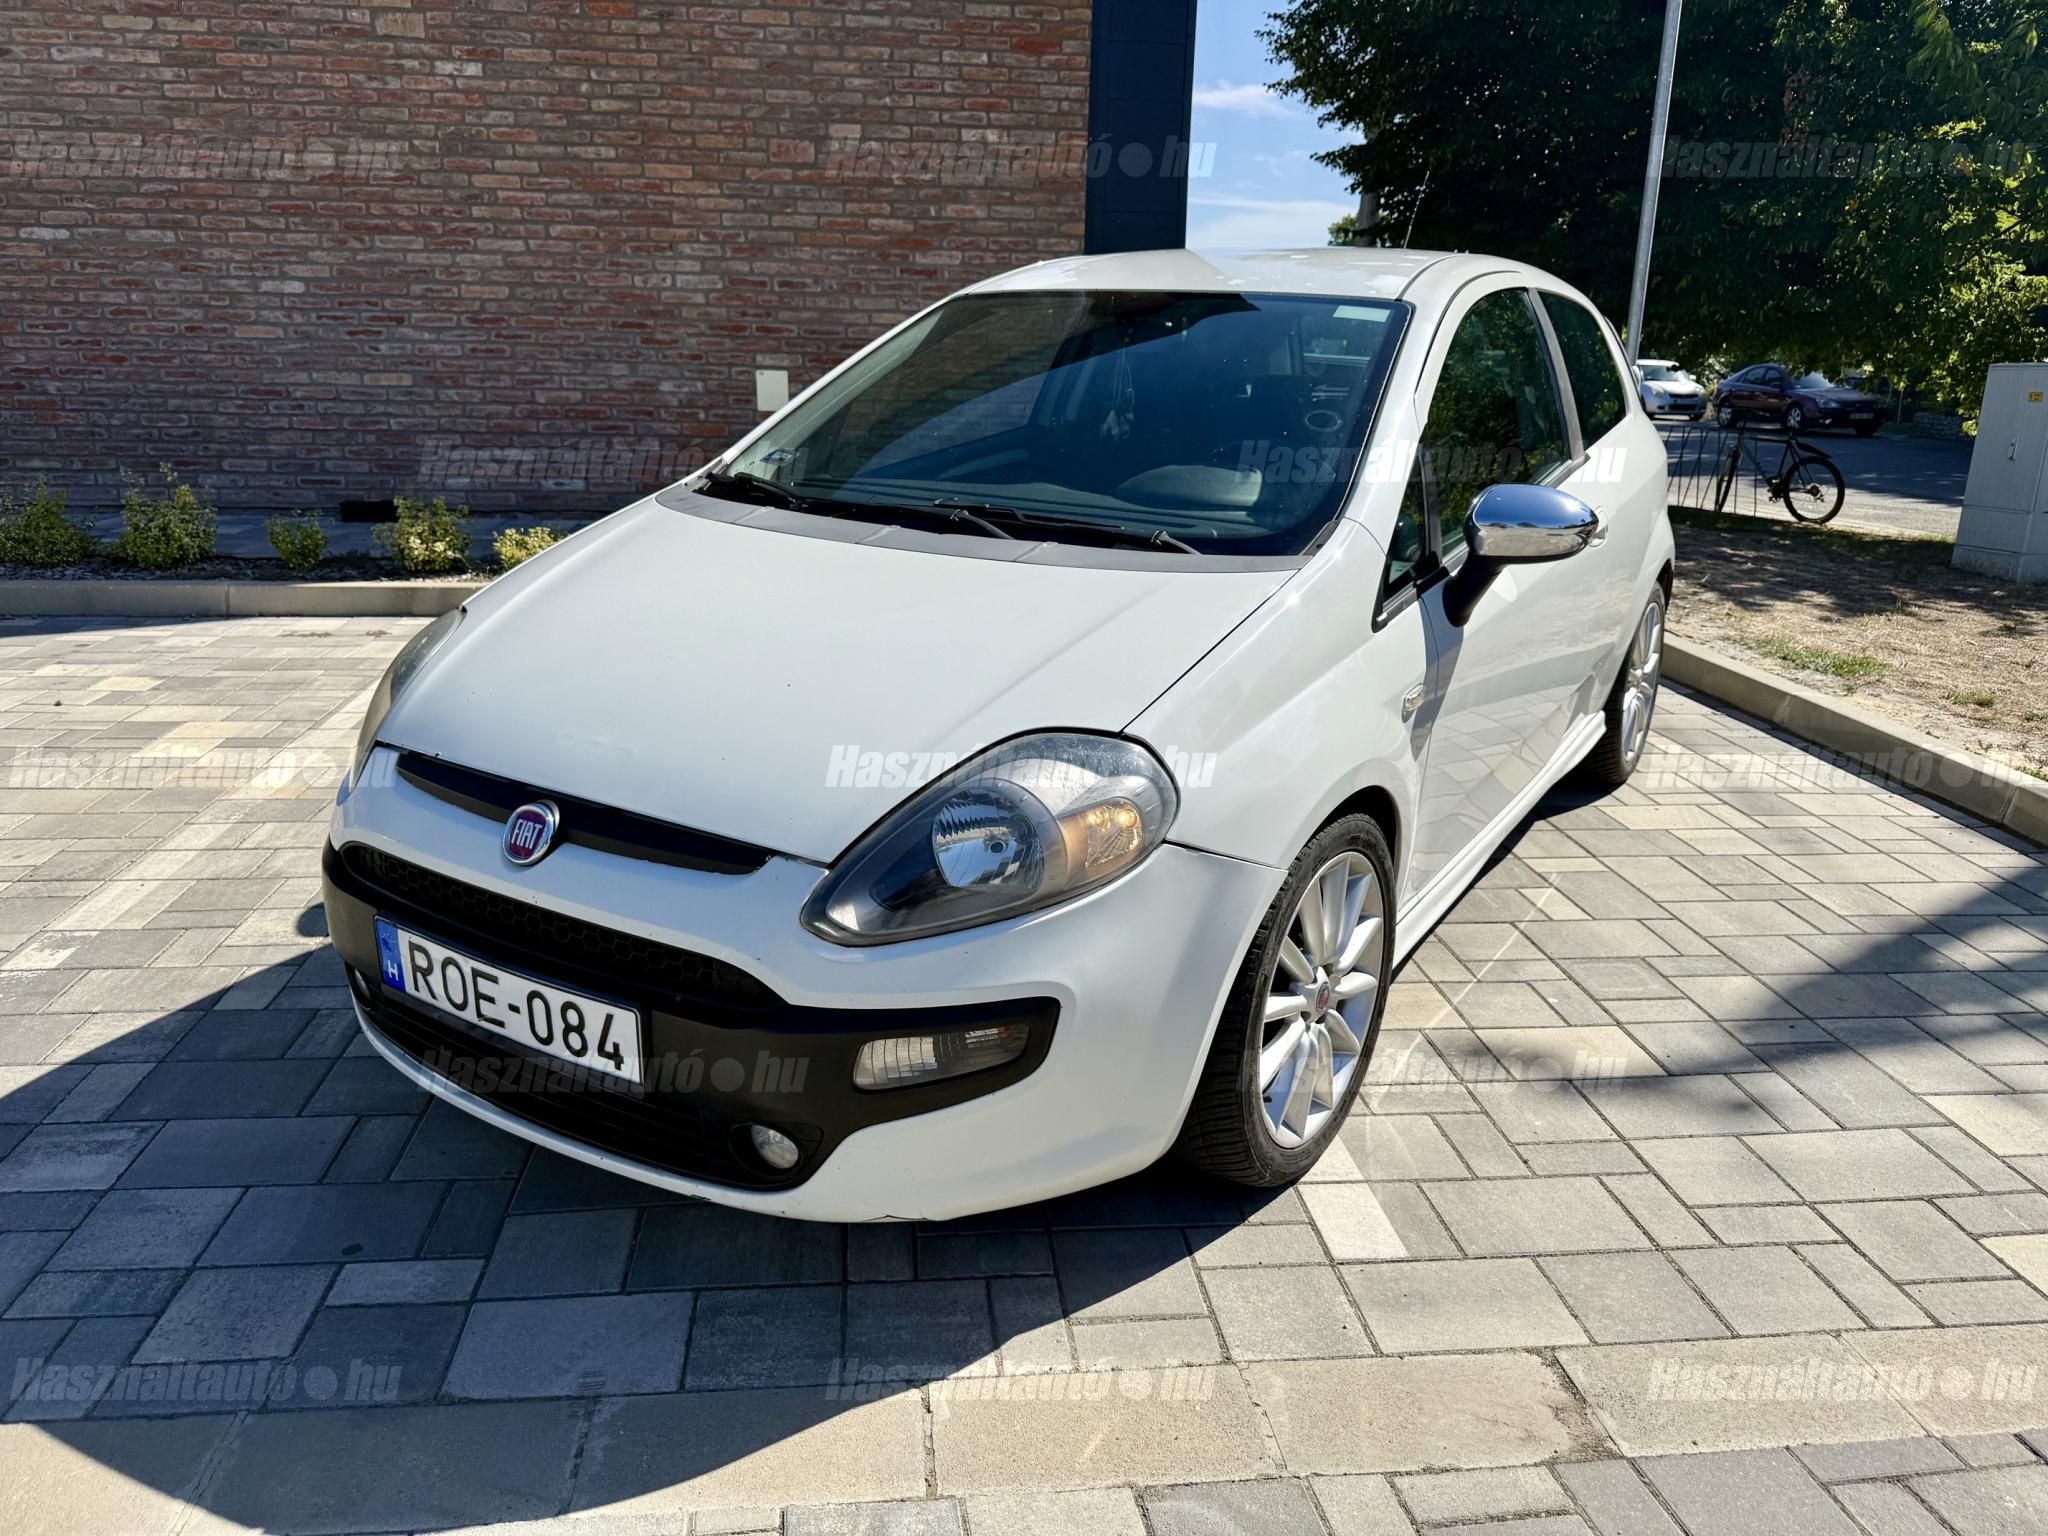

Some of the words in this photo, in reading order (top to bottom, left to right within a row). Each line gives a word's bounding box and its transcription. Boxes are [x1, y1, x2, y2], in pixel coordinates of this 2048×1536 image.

[511, 819, 543, 850] FIAT
[387, 959, 400, 981] H
[407, 937, 625, 1072] ROE-084
